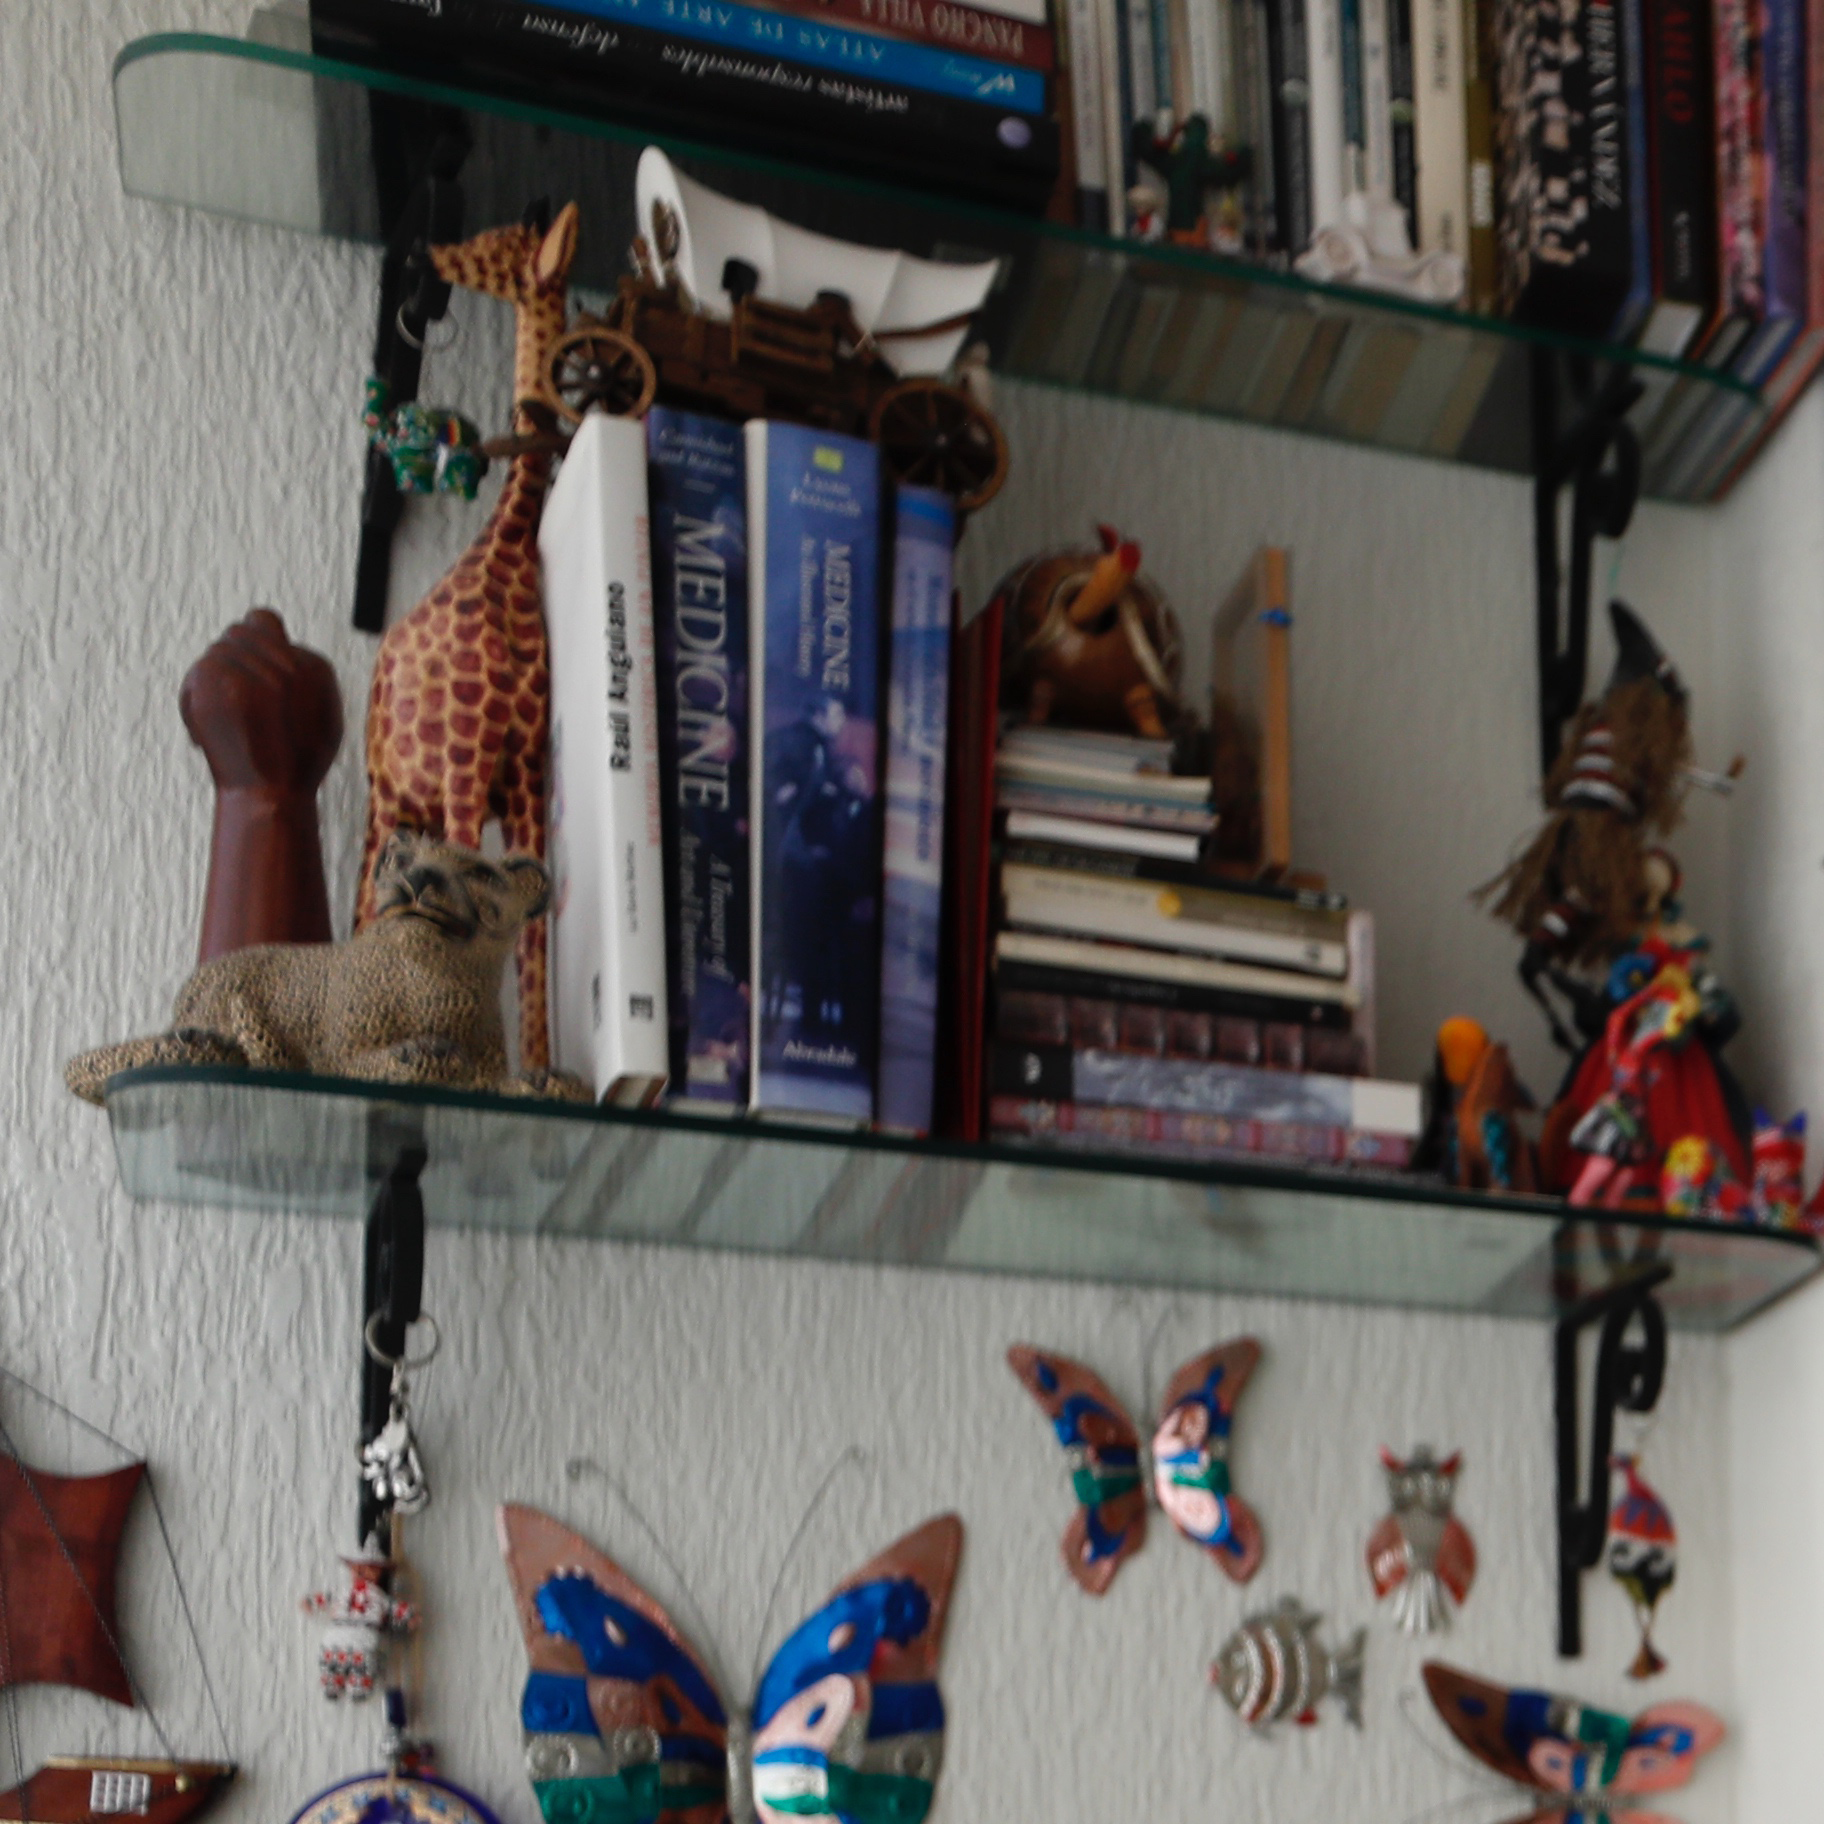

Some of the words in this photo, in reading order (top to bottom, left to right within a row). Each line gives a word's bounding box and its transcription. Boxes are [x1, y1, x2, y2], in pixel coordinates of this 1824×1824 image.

[521, 12, 619, 55] defensa
[798, 27, 887, 63] ATLAS
[930, 4, 1025, 58] PANCHO
[661, 42, 814, 93] responsables
[816, 78, 909, 113] artistas
[605, 581, 634, 702] Anguiano
[821, 537, 852, 694] MEDICINE
[673, 512, 730, 813] MEDICINE
[608, 711, 632, 773] Raúl
